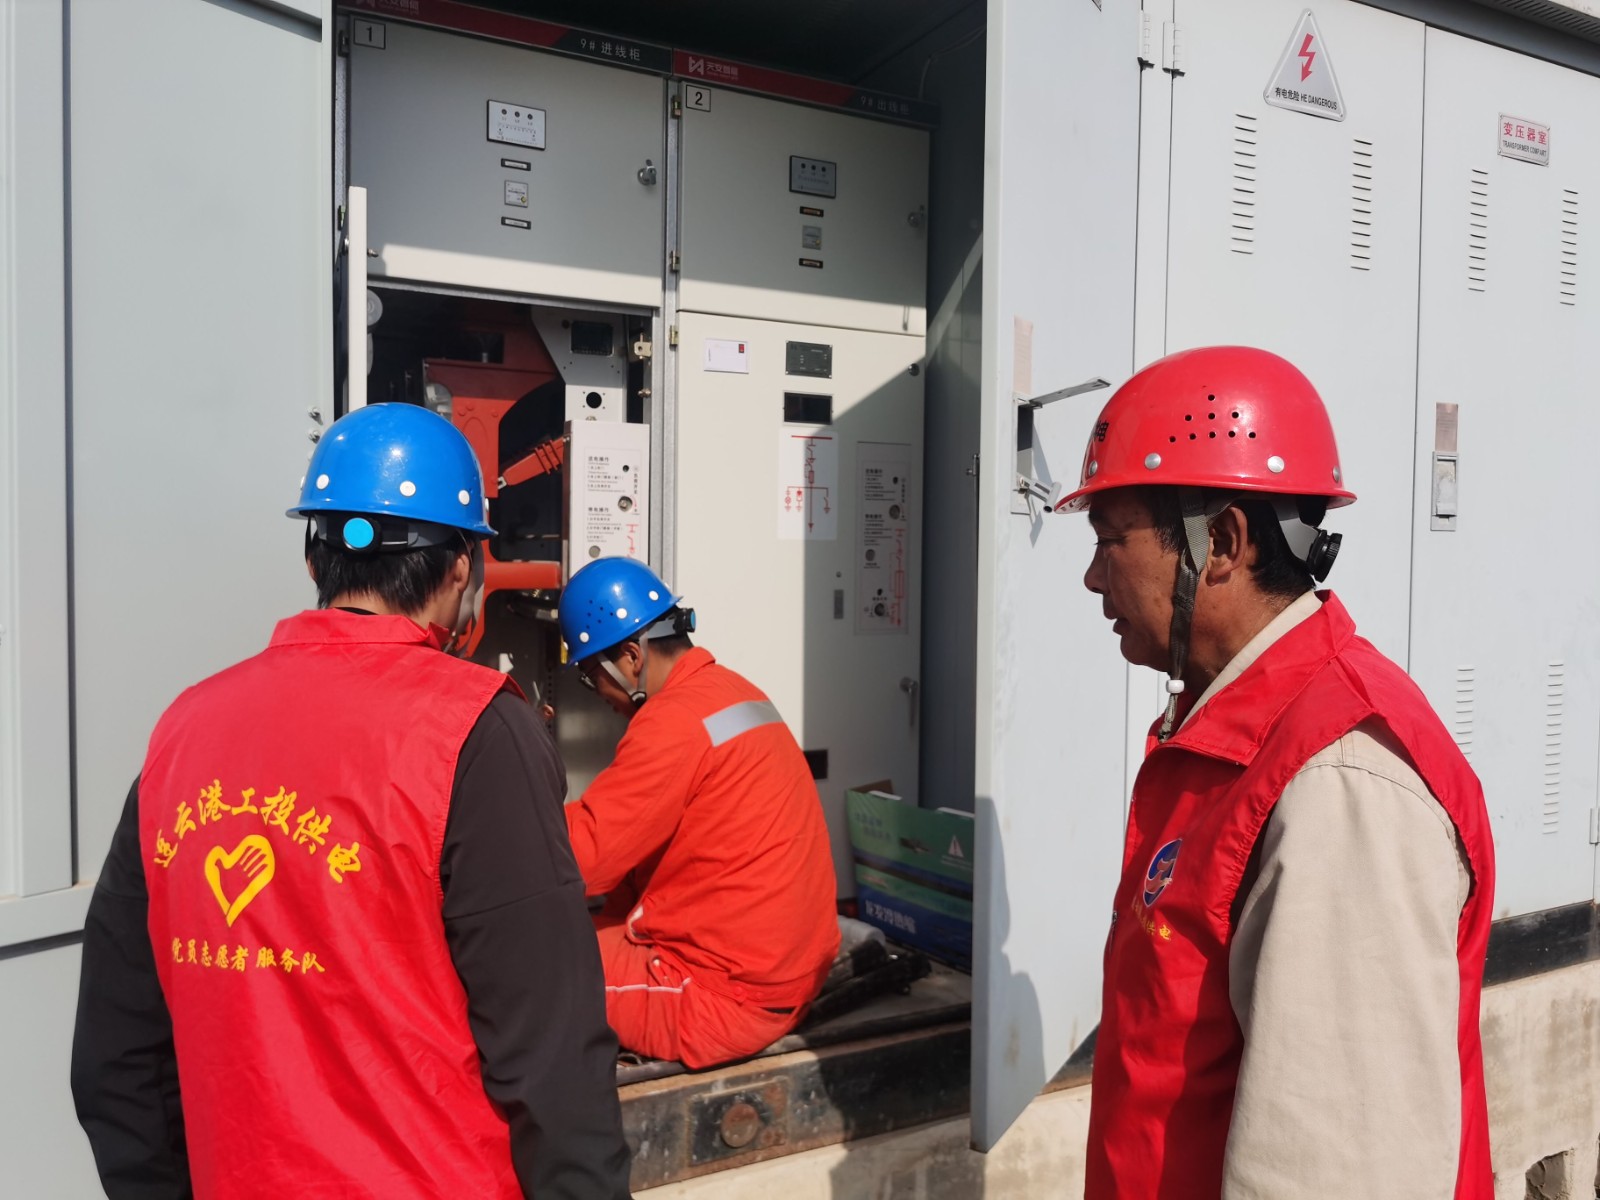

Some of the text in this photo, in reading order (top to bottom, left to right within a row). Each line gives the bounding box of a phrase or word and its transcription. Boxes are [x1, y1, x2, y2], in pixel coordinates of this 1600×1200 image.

[366, 26, 373, 42] 1
[695, 91, 703, 106] 2
[1275, 87, 1300, 102] 有电危险
[1308, 95, 1338, 110] DANGEROUS
[1503, 121, 1547, 145] 变压器室
[1502, 139, 1529, 153] TRANSFORMER
[154, 779, 362, 884] 连云港工投供电
